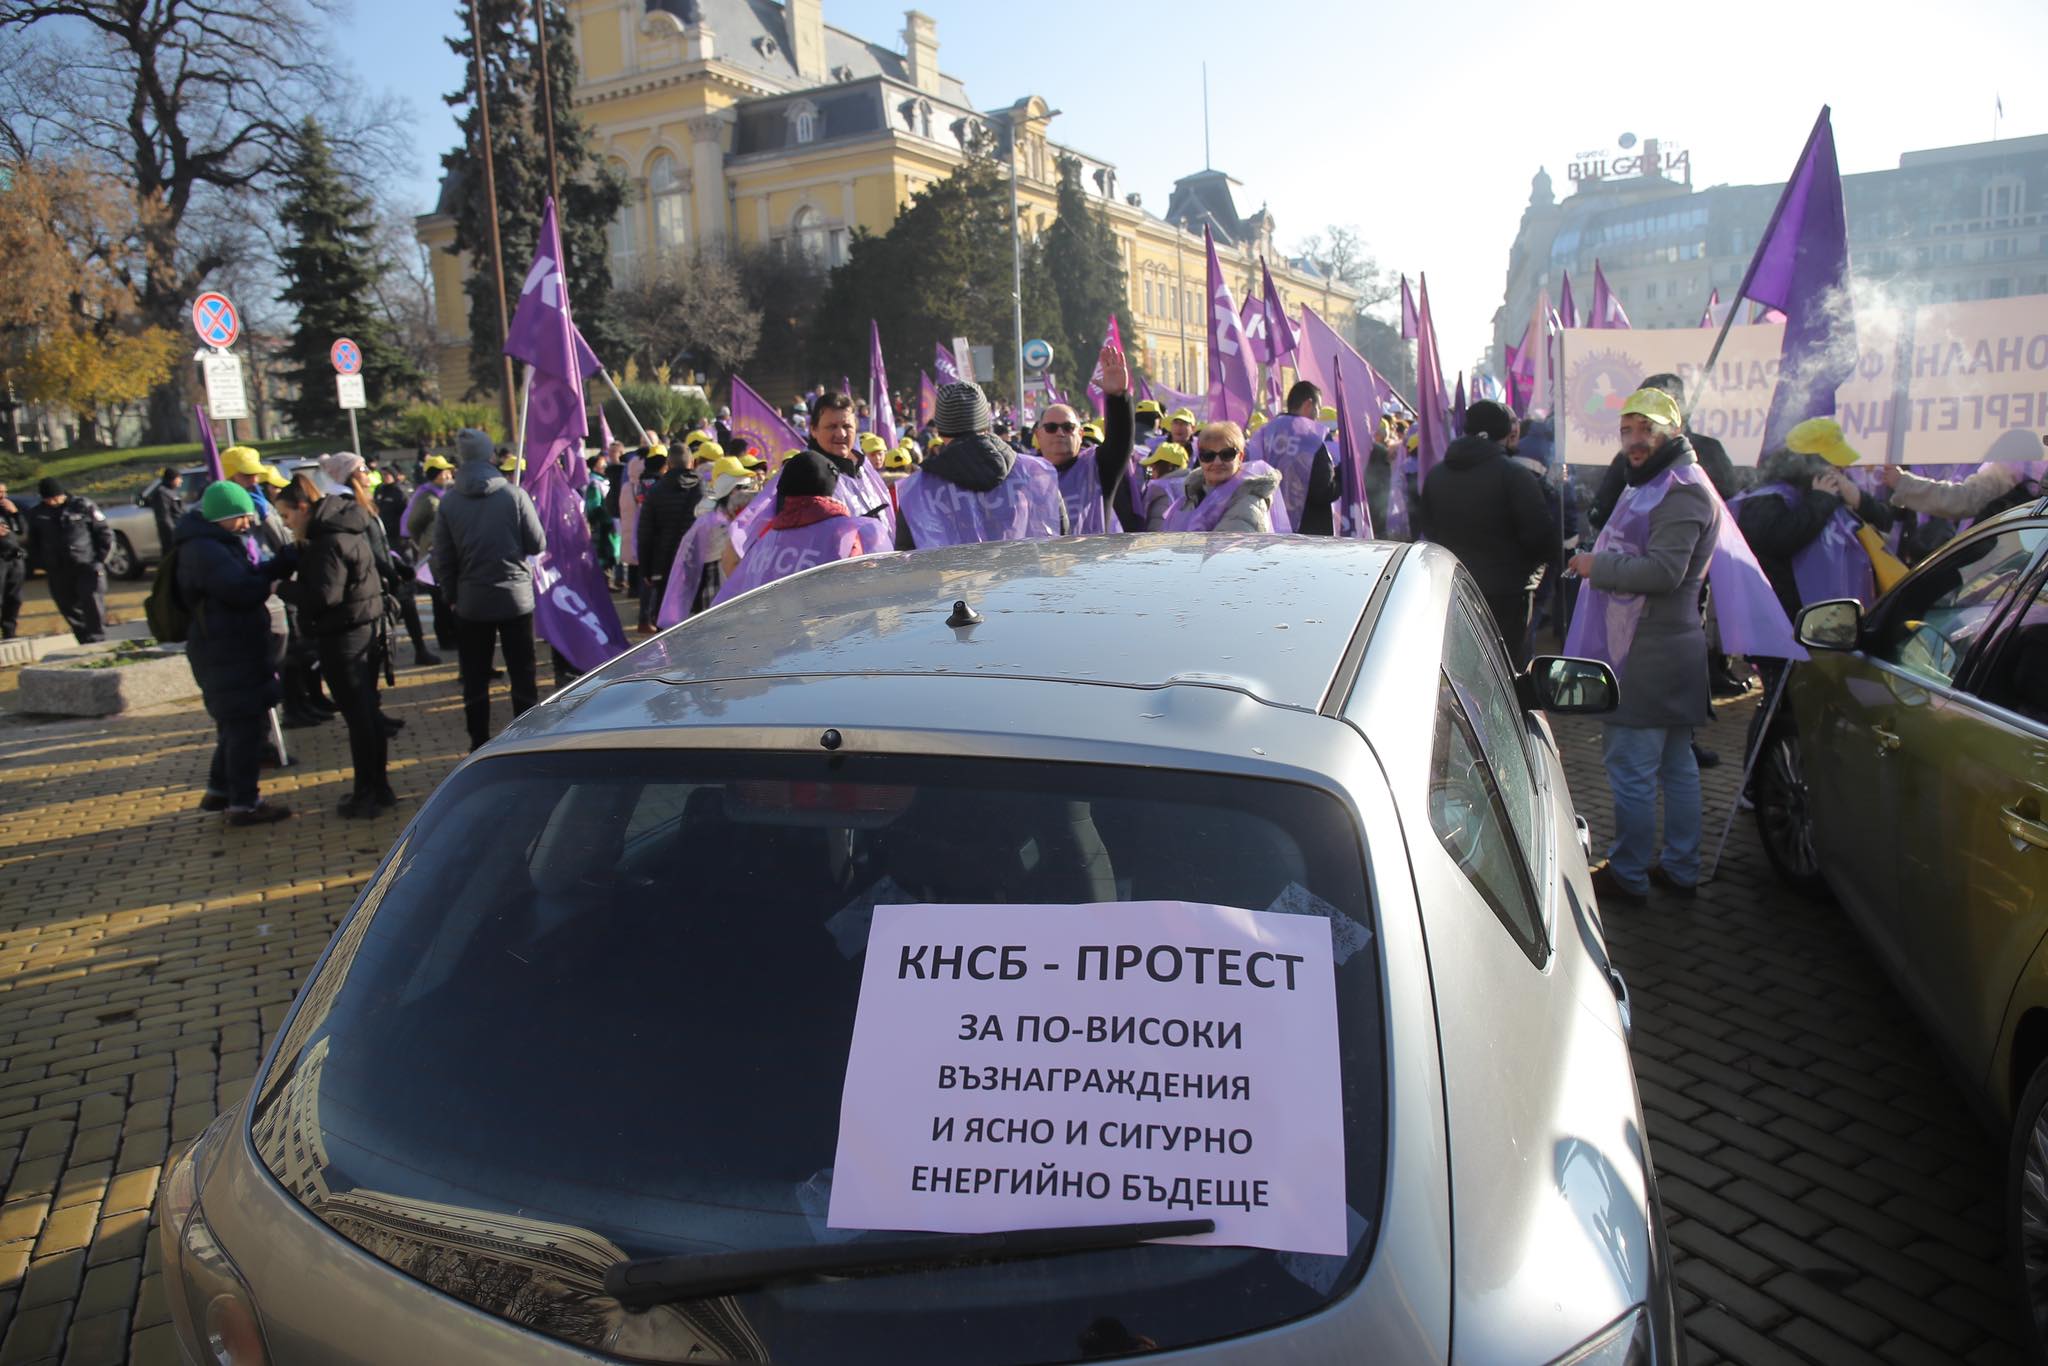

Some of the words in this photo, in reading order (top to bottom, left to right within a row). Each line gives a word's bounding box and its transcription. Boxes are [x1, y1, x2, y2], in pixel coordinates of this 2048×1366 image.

[898, 944, 1028, 981] КНСБ
[1077, 944, 1304, 991] ПРОТЕСТ
[958, 1013, 1004, 1042] ЗА
[1016, 1015, 1242, 1050] ПО-ВИСОКИ
[938, 1065, 1250, 1103] ВЪЗНАГРАЖДЕНИЯ
[932, 1116, 955, 1142] И
[963, 1117, 1055, 1145] ЯСНО
[1065, 1119, 1088, 1146] И
[1099, 1121, 1253, 1155] СИГУРНО
[911, 1161, 1111, 1200] ЕНЕРГИЙНО
[1122, 1174, 1269, 1213] БЪДЕЩЕ
